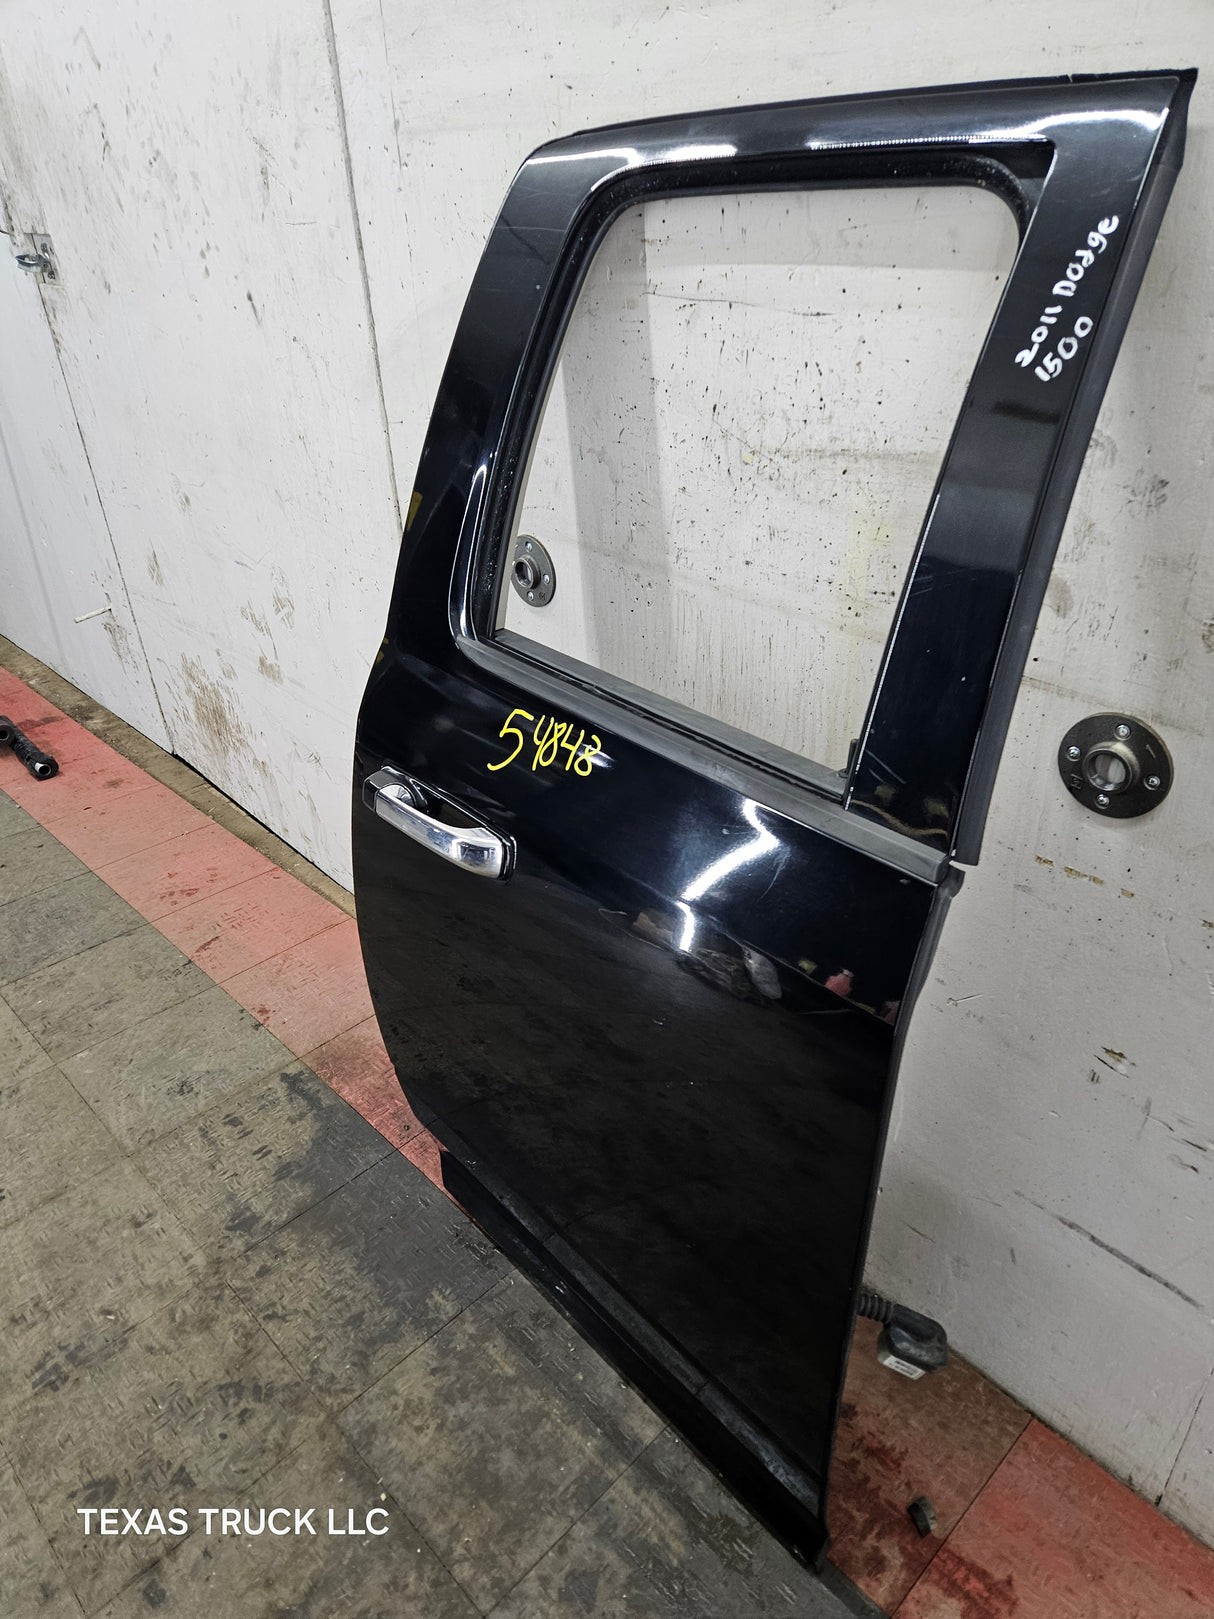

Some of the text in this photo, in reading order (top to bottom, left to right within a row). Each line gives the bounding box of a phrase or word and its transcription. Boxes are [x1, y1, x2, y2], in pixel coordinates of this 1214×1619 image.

[1014, 214, 1120, 368] 2011 Dodge
[1034, 316, 1094, 382] 1500
[486, 708, 602, 777] 54848
